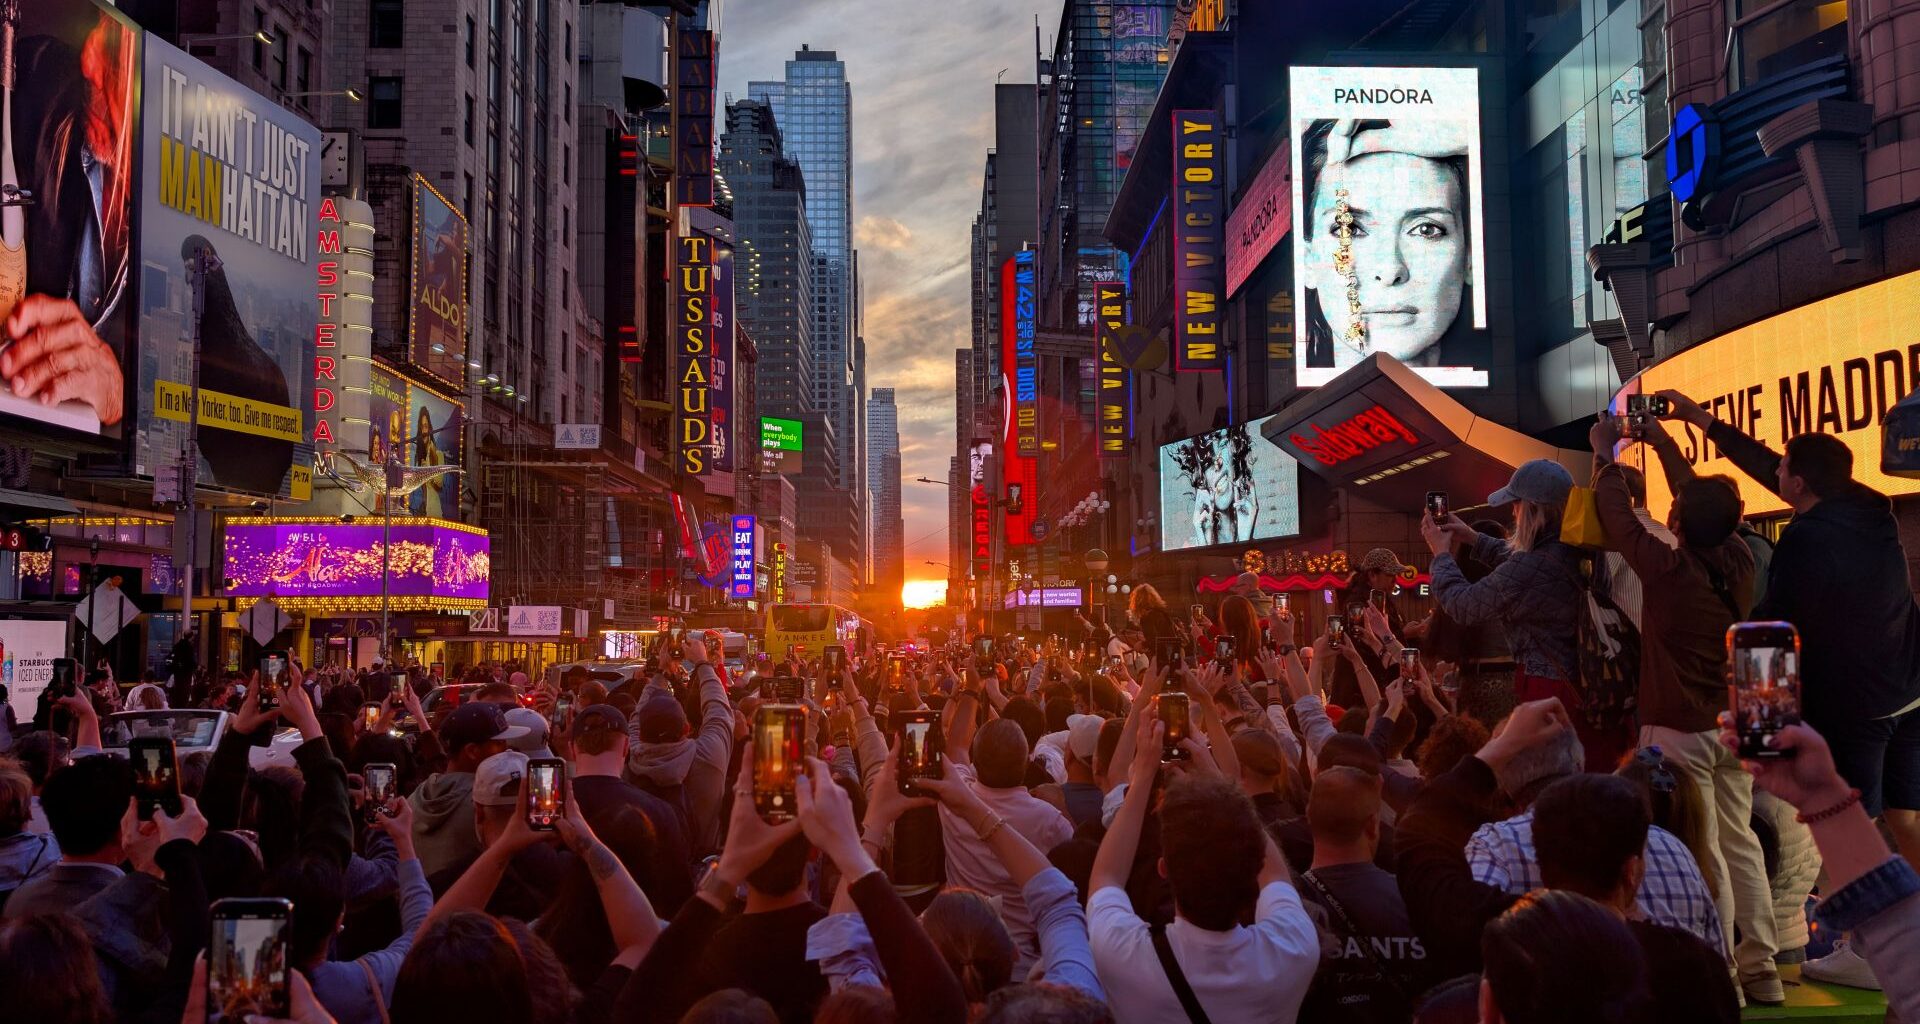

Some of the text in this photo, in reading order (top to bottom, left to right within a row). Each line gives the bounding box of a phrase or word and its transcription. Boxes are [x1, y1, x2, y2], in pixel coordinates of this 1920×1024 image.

[1334, 88, 1433, 104] PANDORA
[161, 64, 309, 200] IT AIN'T JUST
[160, 134, 308, 264] MANHATTAN
[1241, 194, 1278, 249] PANDORA
[1183, 120, 1217, 360] NEW VICTORY
[420, 284, 460, 327] ALDO
[313, 198, 340, 476] AMSTERDAM
[682, 238, 708, 474] TUSSAUD'S
[1017, 339, 1036, 402] SDIOS
[159, 386, 299, 436] I'm a Ne Yorker, too. Give me respect.
[763, 422, 782, 432] When
[763, 432, 798, 443] everybody
[1103, 404, 1124, 451] NEW
[1289, 404, 1420, 466] Subway
[763, 438, 781, 448] plays
[763, 450, 784, 459] We all
[294, 470, 310, 483] PTA
[11, 532, 19, 547] 3
[44, 535, 52, 550] 7
[735, 532, 752, 544] EAT
[976, 508, 990, 570] REGA
[735, 548, 752, 556] DRINK
[735, 560, 751, 569] PLAY
[1243, 549, 1349, 575] Subwa
[776, 554, 785, 604] EMPIRE
[776, 634, 826, 642] YANKEE
[18, 668, 53, 682] ICED ENERG
[19, 659, 54, 667] STARBUCK
[1327, 935, 1427, 960] SANTS
